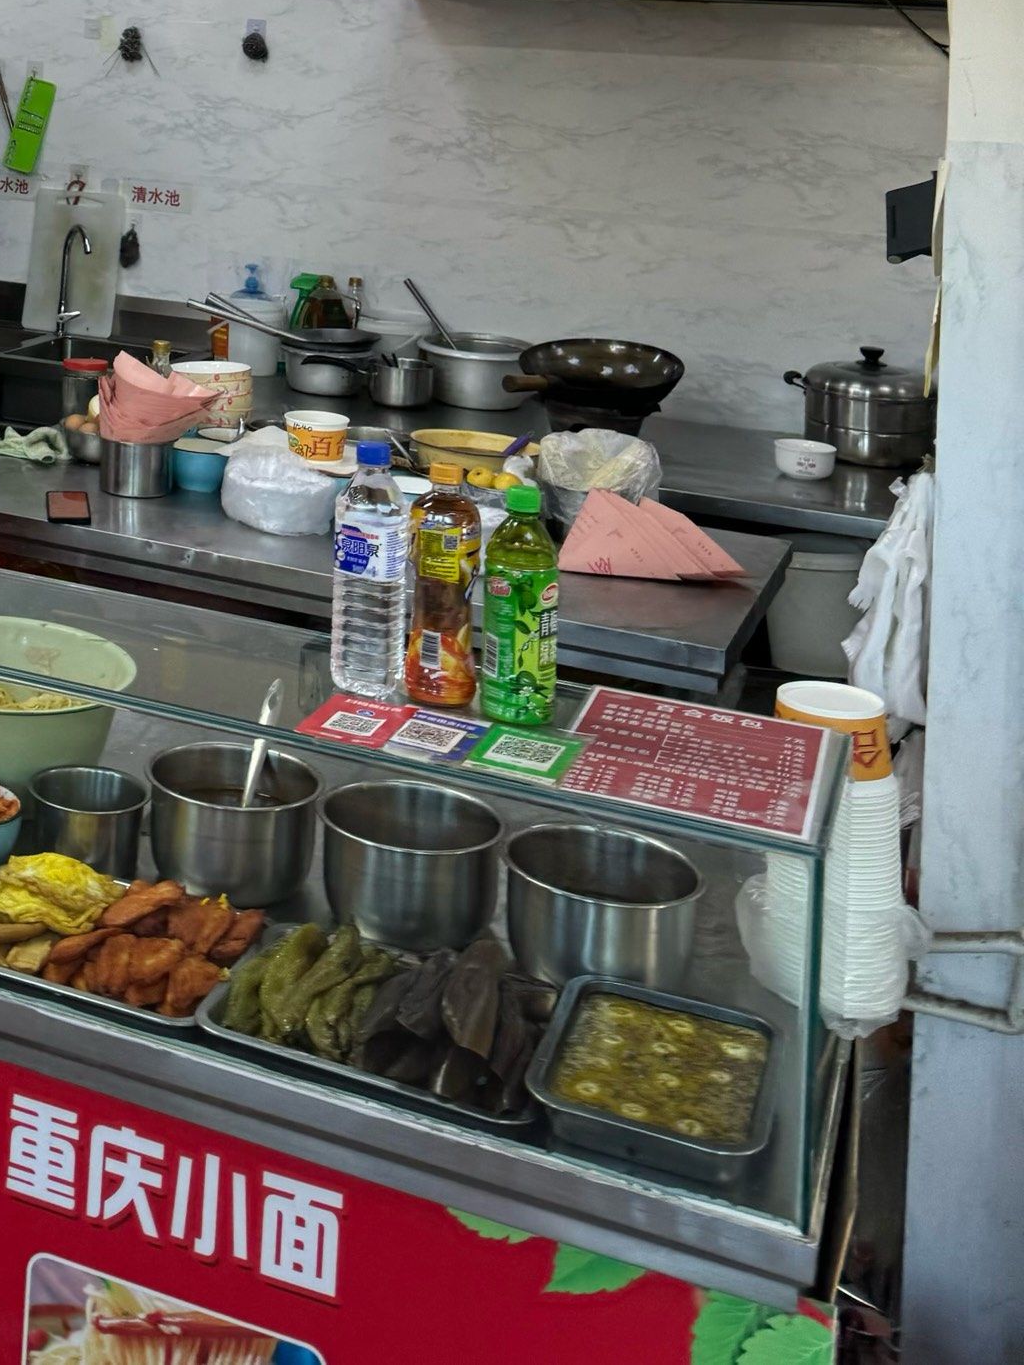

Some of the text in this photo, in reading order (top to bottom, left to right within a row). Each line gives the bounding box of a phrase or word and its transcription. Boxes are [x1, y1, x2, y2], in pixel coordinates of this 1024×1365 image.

[132, 186, 181, 207] 清水池
[6, 1093, 344, 1300] 重庆小面
